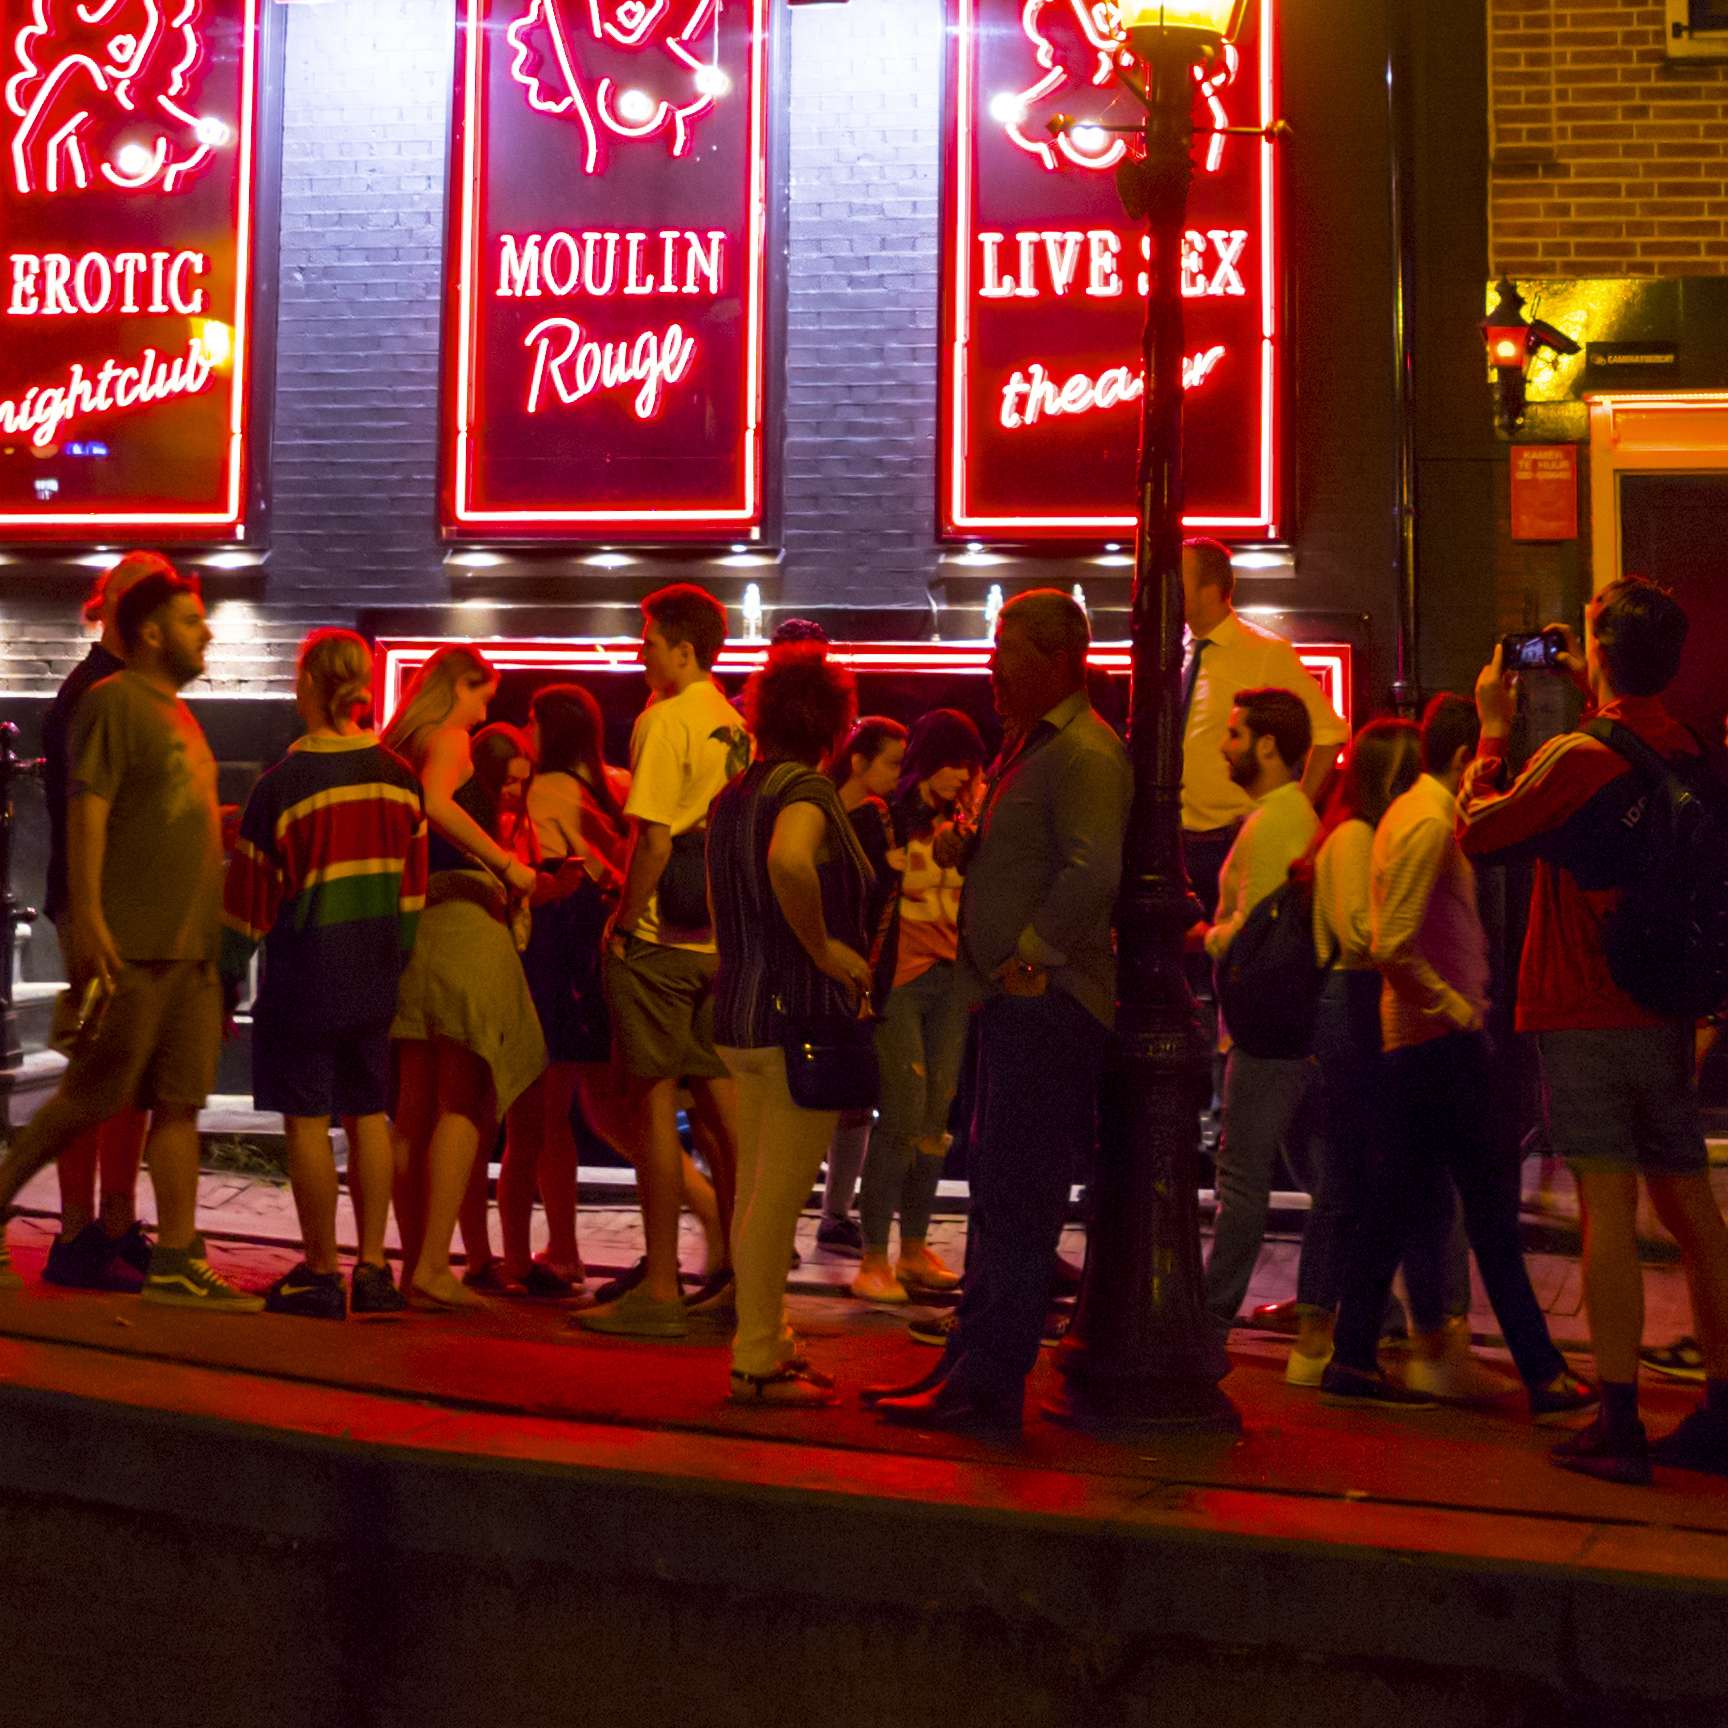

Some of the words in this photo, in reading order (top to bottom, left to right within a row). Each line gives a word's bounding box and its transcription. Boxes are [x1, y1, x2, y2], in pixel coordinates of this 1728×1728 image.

[6, 250, 204, 315] EROTIC
[495, 229, 727, 298] MOULIN
[977, 229, 1123, 298] LIVE
[523, 316, 695, 420] Rouge
